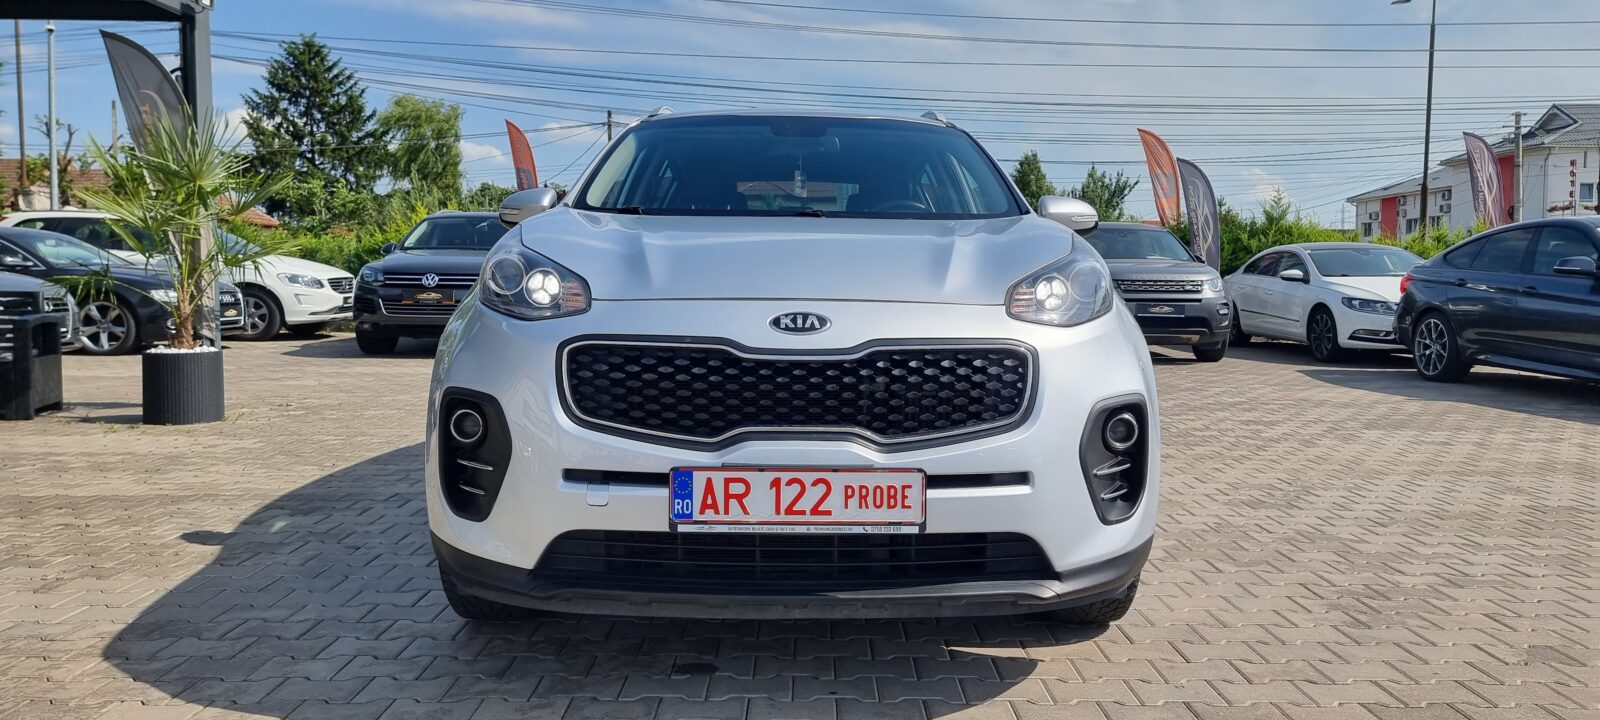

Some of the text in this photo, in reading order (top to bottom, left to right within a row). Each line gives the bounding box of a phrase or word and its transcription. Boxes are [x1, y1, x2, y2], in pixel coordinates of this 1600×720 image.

[779, 314, 821, 329] KIA
[698, 477, 913, 516] AR 122 PROBE
[674, 498, 692, 515] RO
